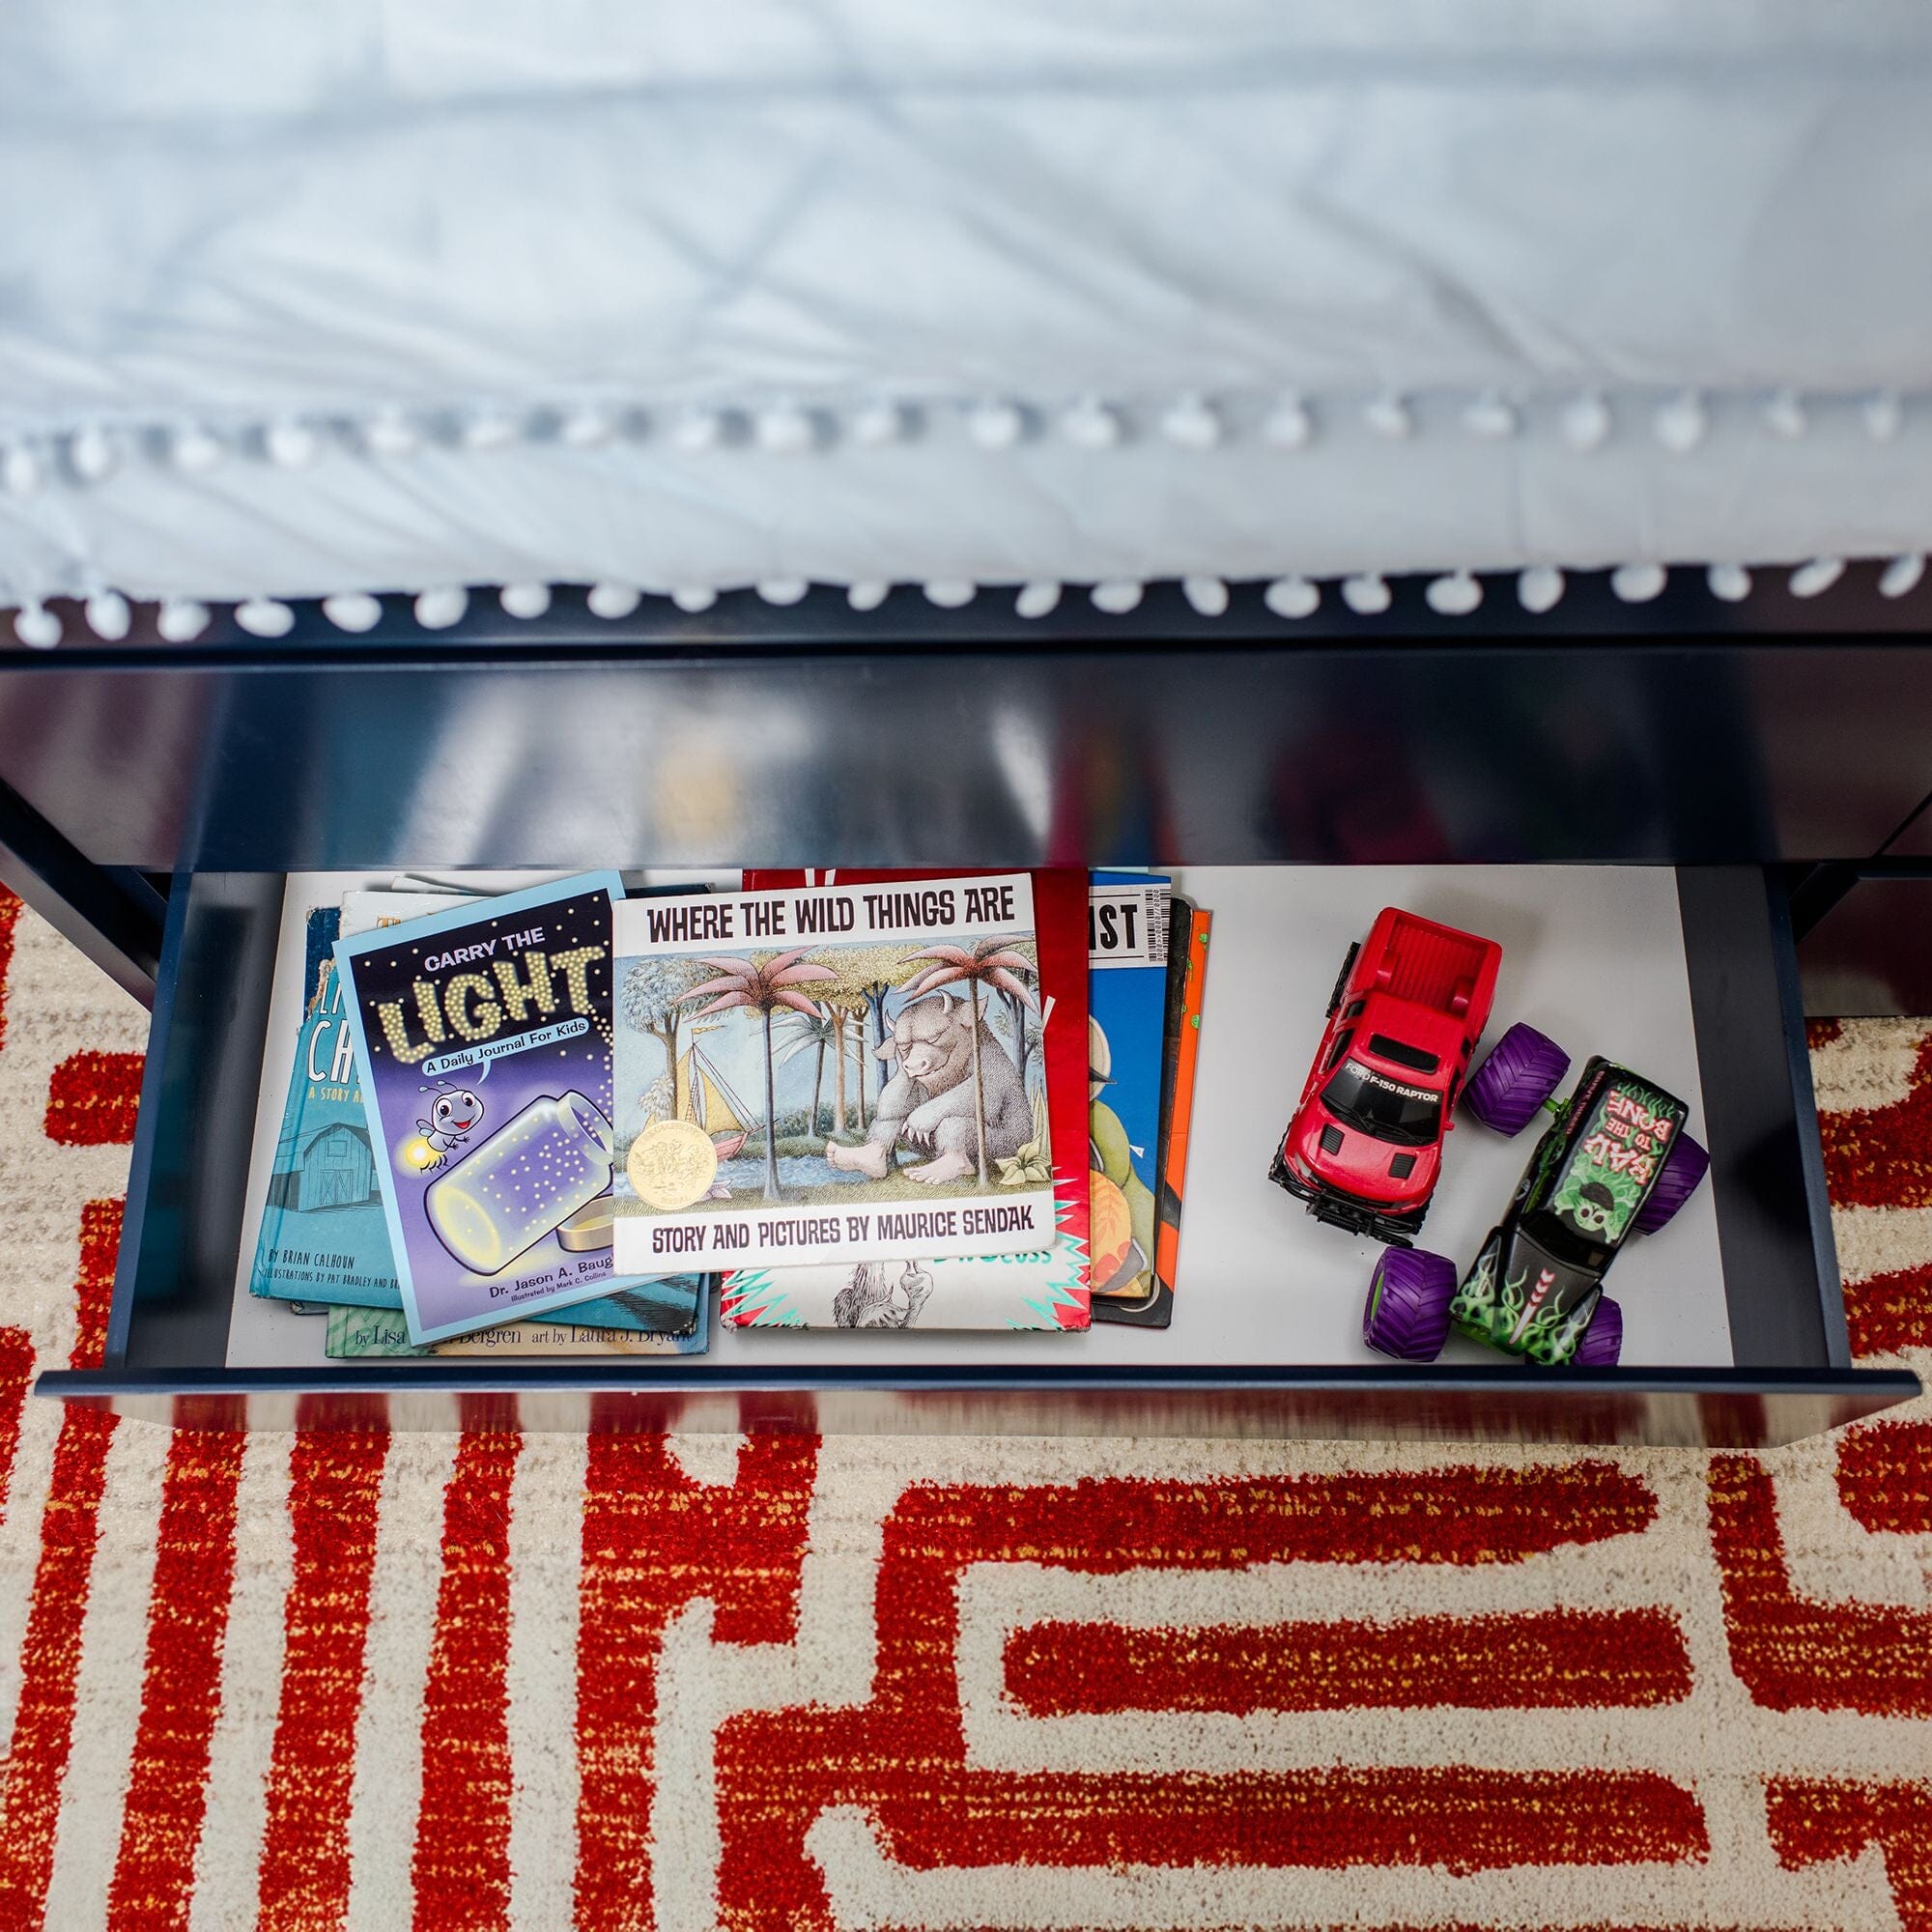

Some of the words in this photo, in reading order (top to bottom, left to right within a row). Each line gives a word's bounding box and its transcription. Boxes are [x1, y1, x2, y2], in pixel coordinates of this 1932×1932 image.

[647, 904, 733, 944] WHERE
[740, 900, 786, 937] THE
[795, 897, 855, 934] WILD
[863, 890, 955, 929] THINGS
[964, 885, 1015, 923] ARE
[424, 939, 497, 973] CARRY
[501, 926, 546, 952] THE
[378, 946, 606, 1064] LIGHT
[308, 1019, 360, 1084] CH
[426, 1062, 437, 1073] A
[440, 1052, 473, 1069] Daily
[478, 1037, 526, 1060] Journal
[529, 1029, 553, 1044] For
[556, 1020, 586, 1037] Kids
[308, 1087, 315, 1098] A
[321, 1088, 349, 1102] STORY
[1345, 1063, 1370, 1081] FORD
[1370, 1075, 1396, 1092] F-150
[1396, 1086, 1438, 1102] RAPTOR
[1605, 1118, 1631, 1138] THE
[1606, 1089, 1672, 1143] BONE
[1634, 1133, 1652, 1151] TO
[652, 1225, 706, 1254] STORY
[713, 1223, 750, 1250] AND
[758, 1217, 840, 1247] PICTURES
[846, 1215, 869, 1241] BY
[878, 1211, 957, 1240] MAURICE
[963, 1205, 1035, 1236] SENDAK
[264, 1267, 313, 1282] ILLUSTRATIONS
[316, 1272, 325, 1283] BY
[327, 1273, 340, 1284] PAT
[343, 1275, 372, 1287] BRADLEY
[373, 1277, 387, 1289] AND
[268, 1248, 278, 1263] BY
[282, 1250, 309, 1265] BRIAN
[314, 1253, 355, 1269] CALHOUN
[490, 1286, 509, 1298] Dr.
[514, 1274, 554, 1292] Jason
[558, 1266, 573, 1279] A.
[578, 1253, 613, 1273] Baug
[511, 1288, 544, 1301] Illustrated
[556, 1279, 573, 1289] Mark
[584, 1271, 607, 1281] Collins
[355, 1330, 371, 1348] by
[373, 1324, 405, 1345] Lisa
[531, 1329, 552, 1343] art
[553, 1328, 567, 1347] by
[570, 1325, 616, 1344] Laura
